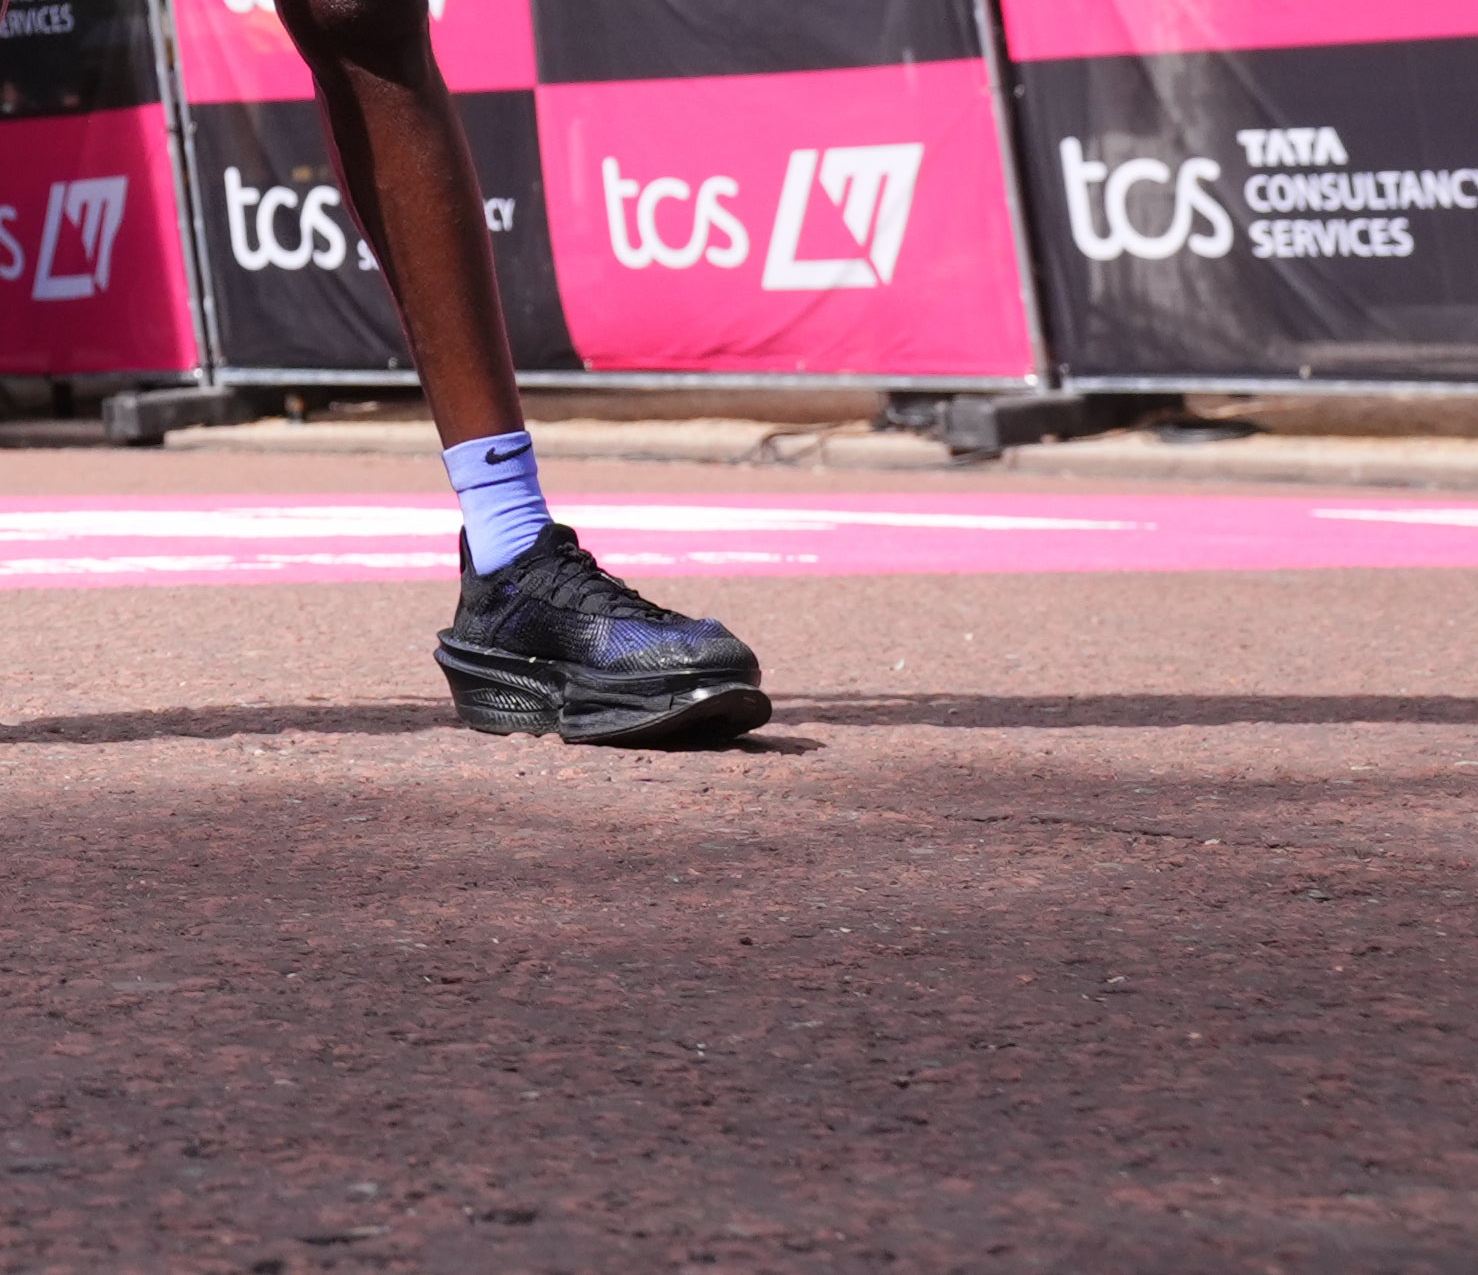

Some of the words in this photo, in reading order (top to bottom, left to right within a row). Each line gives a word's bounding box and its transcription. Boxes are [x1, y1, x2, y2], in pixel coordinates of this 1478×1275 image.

[1059, 135, 1235, 261] tcs
[1236, 126, 1348, 167] TATA
[223, 166, 347, 271] tcs
[601, 155, 751, 269] tcs
[1249, 216, 1415, 259] SERVICES
